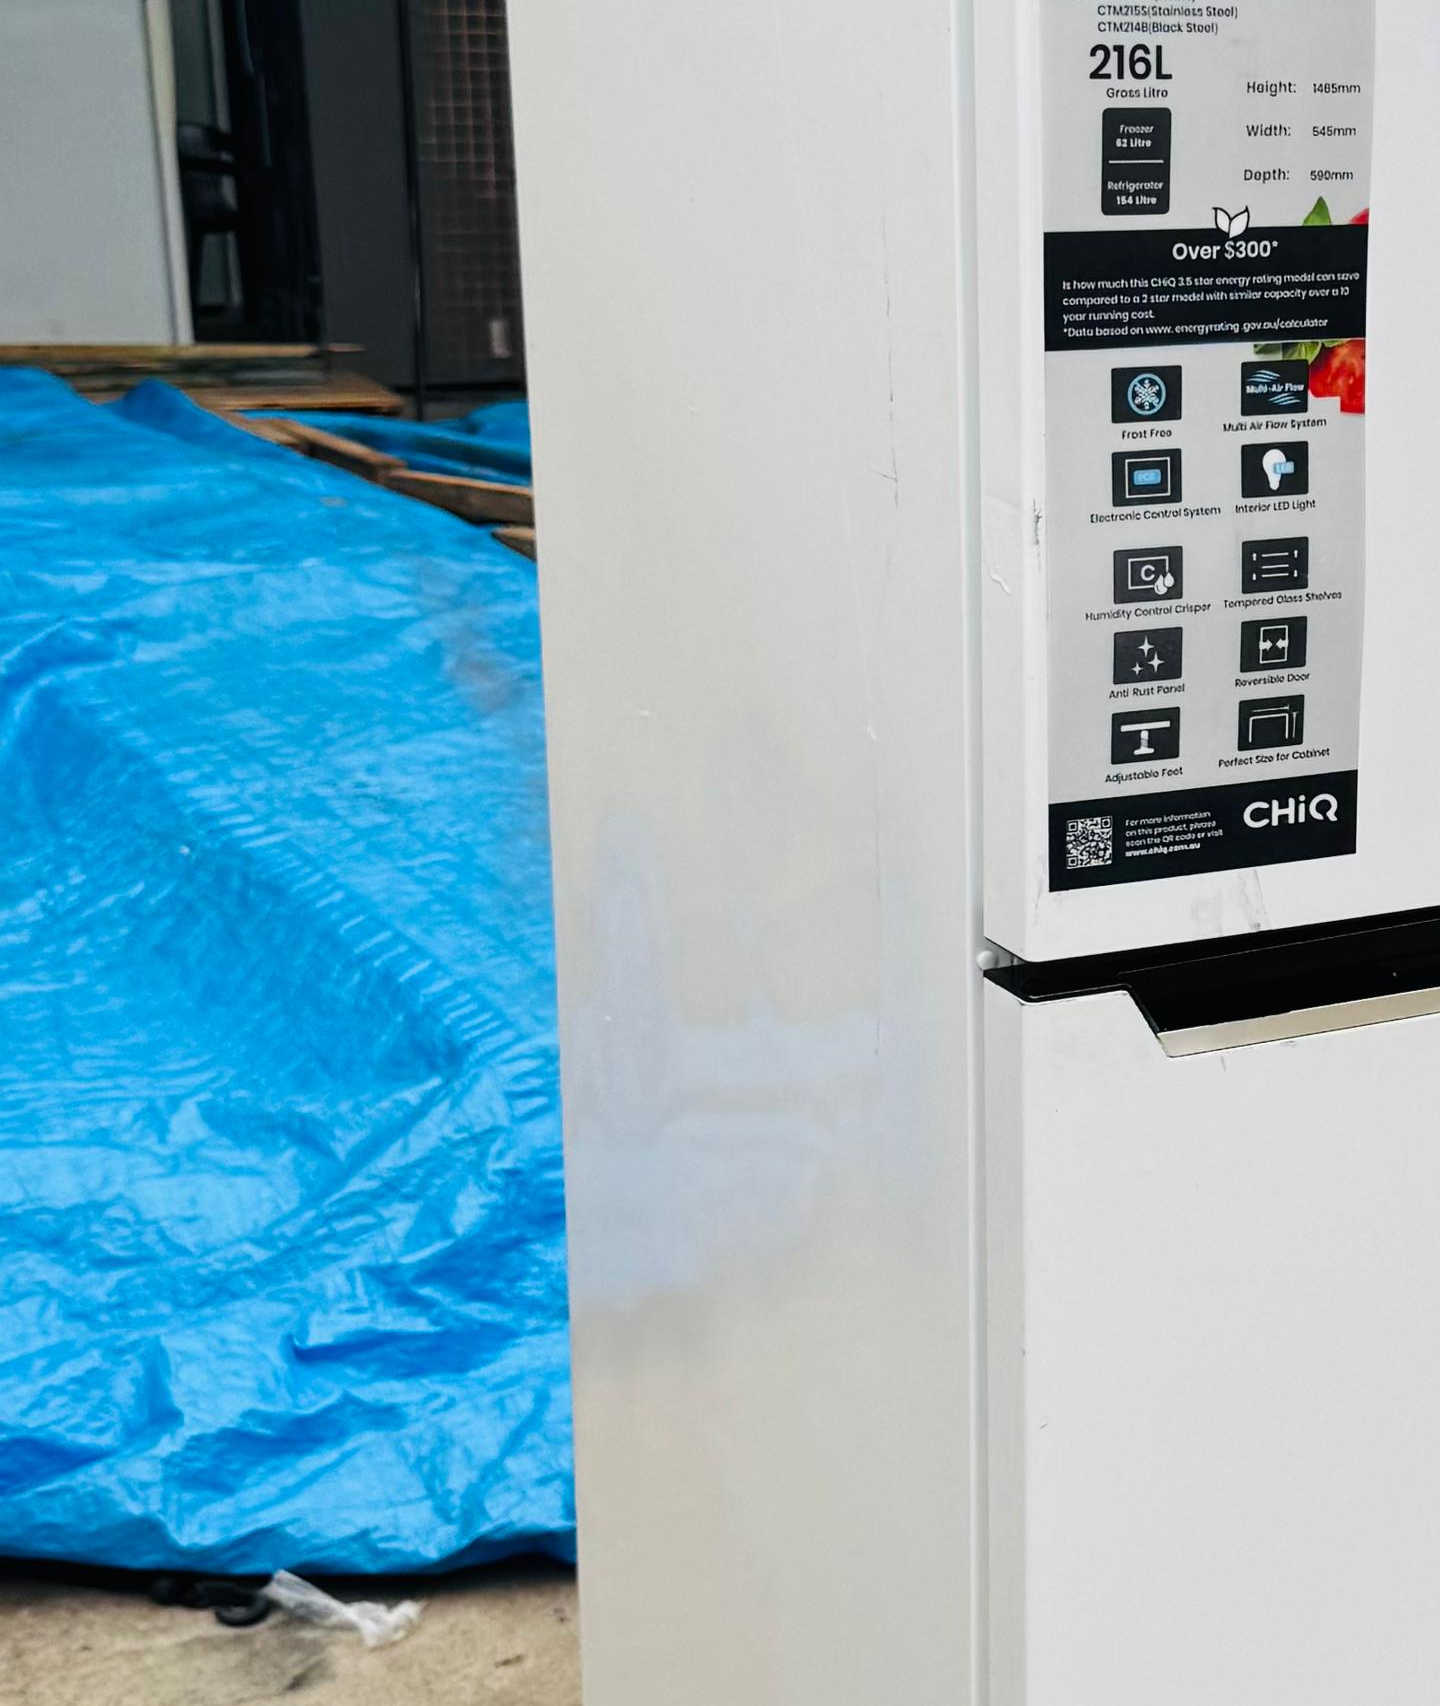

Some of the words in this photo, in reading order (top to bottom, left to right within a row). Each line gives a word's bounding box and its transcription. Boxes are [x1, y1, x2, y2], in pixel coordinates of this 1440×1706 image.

[1089, 43, 1172, 80] 216L
[1106, 87, 1140, 99] Gross
[1144, 87, 1168, 99] Litre
[1246, 81, 1296, 97] Height:
[1246, 124, 1292, 137] Width:
[1244, 168, 1290, 185] Depth:
[1107, 181, 1164, 193] Refrigerator
[1172, 243, 1221, 261] Over
[1073, 280, 1096, 290] how
[1098, 279, 1128, 289] much
[1130, 277, 1148, 288] this
[1216, 276, 1250, 287] energy
[1252, 273, 1282, 285] rating
[1062, 293, 1118, 309] compared
[1120, 295, 1131, 304] to
[1088, 309, 1130, 323] running
[1130, 327, 1144, 335] on
[1122, 429, 1148, 440] Frost
[1150, 429, 1172, 438] Free
[1090, 510, 1141, 523] Electronic
[1144, 509, 1182, 521] Control
[1184, 506, 1221, 519] System
[1236, 503, 1270, 514] Interior
[1273, 501, 1290, 511] LED
[1292, 499, 1316, 512] Light
[1140, 565, 1156, 581] C
[1224, 597, 1274, 609] Tempered
[1305, 590, 1342, 602] Shelves
[1085, 609, 1132, 621] Humidity
[1134, 605, 1172, 617] Control
[1175, 603, 1211, 615] Crisper
[1234, 675, 1285, 687] Reversible
[1287, 673, 1310, 682] Door
[1108, 689, 1129, 699] Anti
[1132, 687, 1154, 697] Rust
[1156, 683, 1185, 695] Panel
[1218, 757, 1253, 767] Perfect
[1256, 755, 1274, 763] Size
[1276, 752, 1290, 761] for
[1292, 748, 1330, 759] Cabinet
[1105, 769, 1160, 784] Adjustable
[1243, 793, 1338, 829] CHiQ
